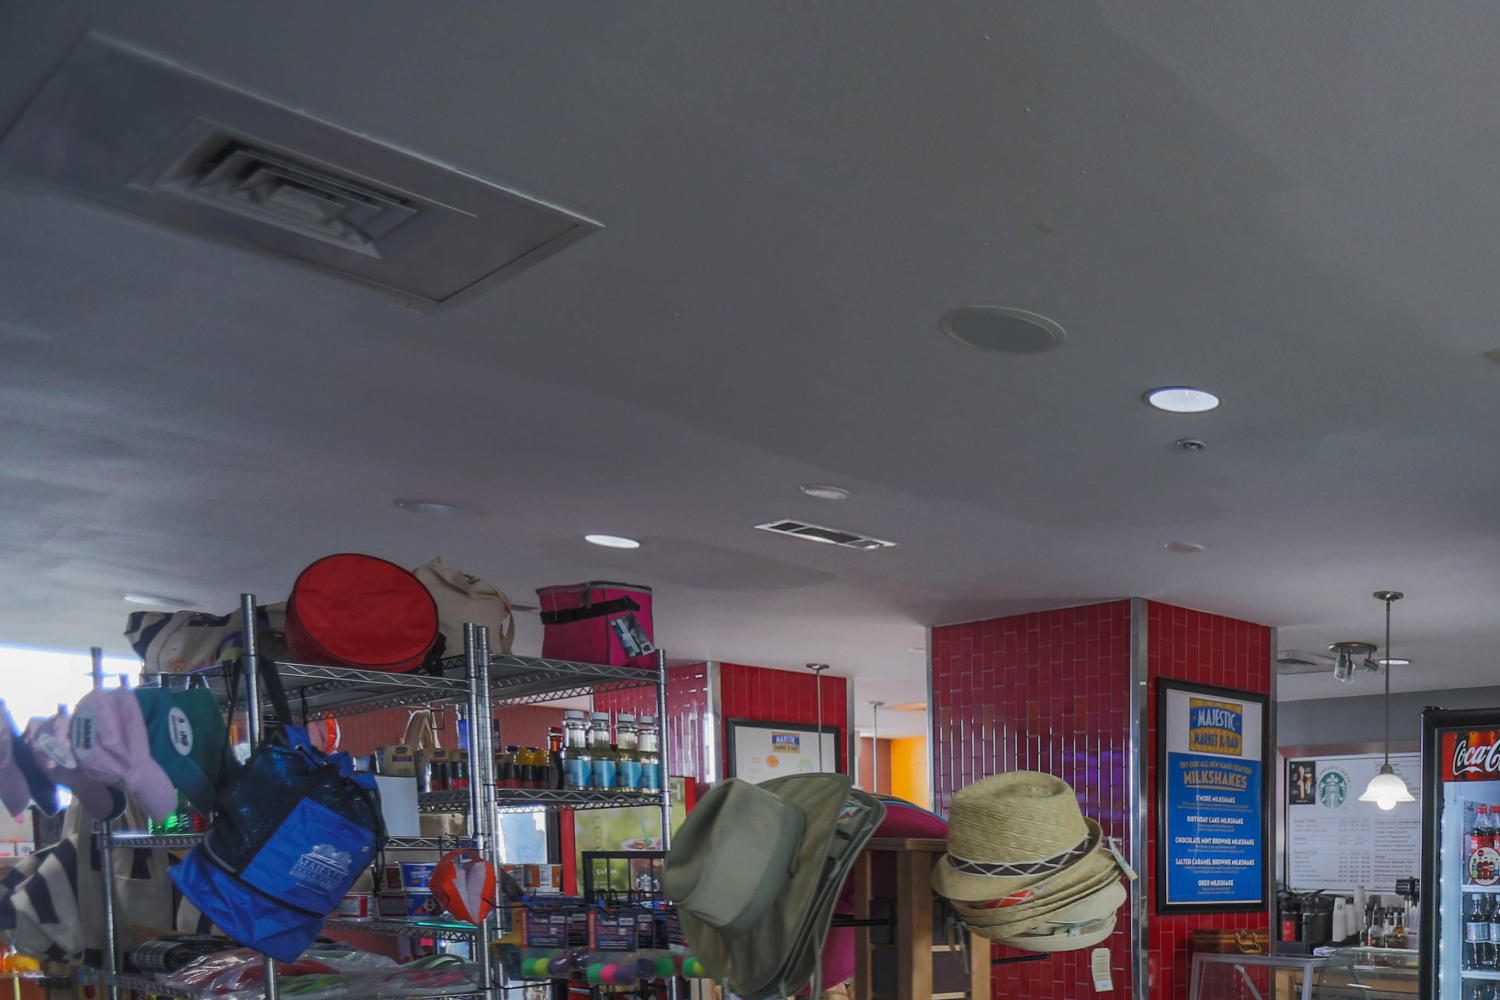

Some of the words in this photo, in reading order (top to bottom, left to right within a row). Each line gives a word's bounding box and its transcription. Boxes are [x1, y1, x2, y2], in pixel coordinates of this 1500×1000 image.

[1197, 708, 1237, 732] MAJESTIC
[1183, 770, 1249, 789] MILKSHAKES
[1174, 836, 1201, 845] CHOCOLATE
